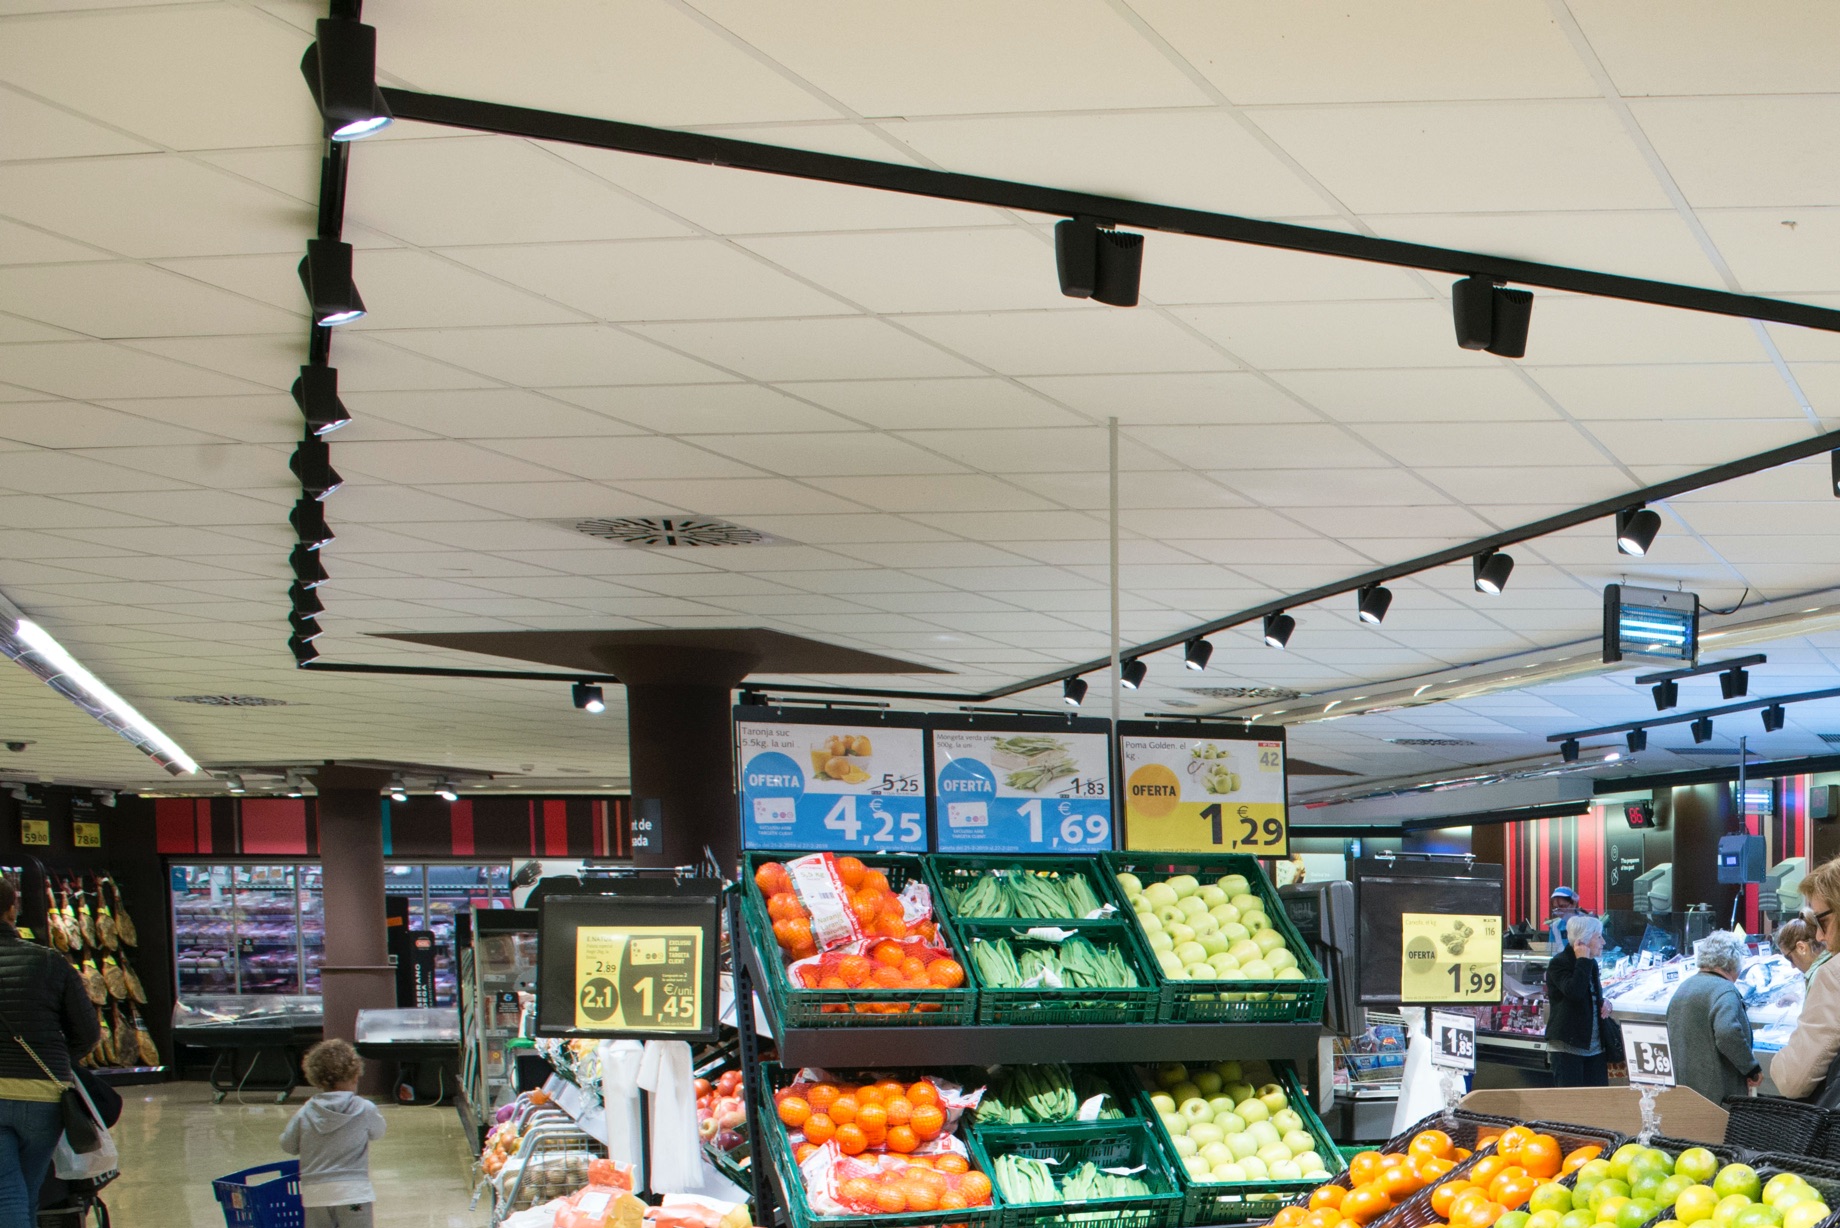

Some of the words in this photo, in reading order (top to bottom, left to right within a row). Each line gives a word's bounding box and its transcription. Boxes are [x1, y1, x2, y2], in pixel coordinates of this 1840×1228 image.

[742, 727, 774, 738] Taronja
[775, 729, 790, 737] suc
[937, 733, 964, 741] Mongeta
[771, 739, 779, 747] la
[781, 740, 795, 748] uni
[1126, 741, 1147, 749] Poma
[1179, 742, 1186, 750] el
[1260, 752, 1280, 766] 42
[749, 774, 800, 788] OFERTA
[943, 780, 992, 792] OFERTA
[1133, 785, 1176, 796] OFERTA
[1628, 807, 1643, 824] 86
[638, 818, 652, 830] de
[1485, 927, 1496, 936] 116
[1409, 951, 1435, 960] OFERTA
[1448, 963, 1496, 996] 1,99
[664, 983, 694, 996] €/uni.
[583, 986, 612, 1008] 2x1
[1640, 1042, 1670, 1074] 3,69
